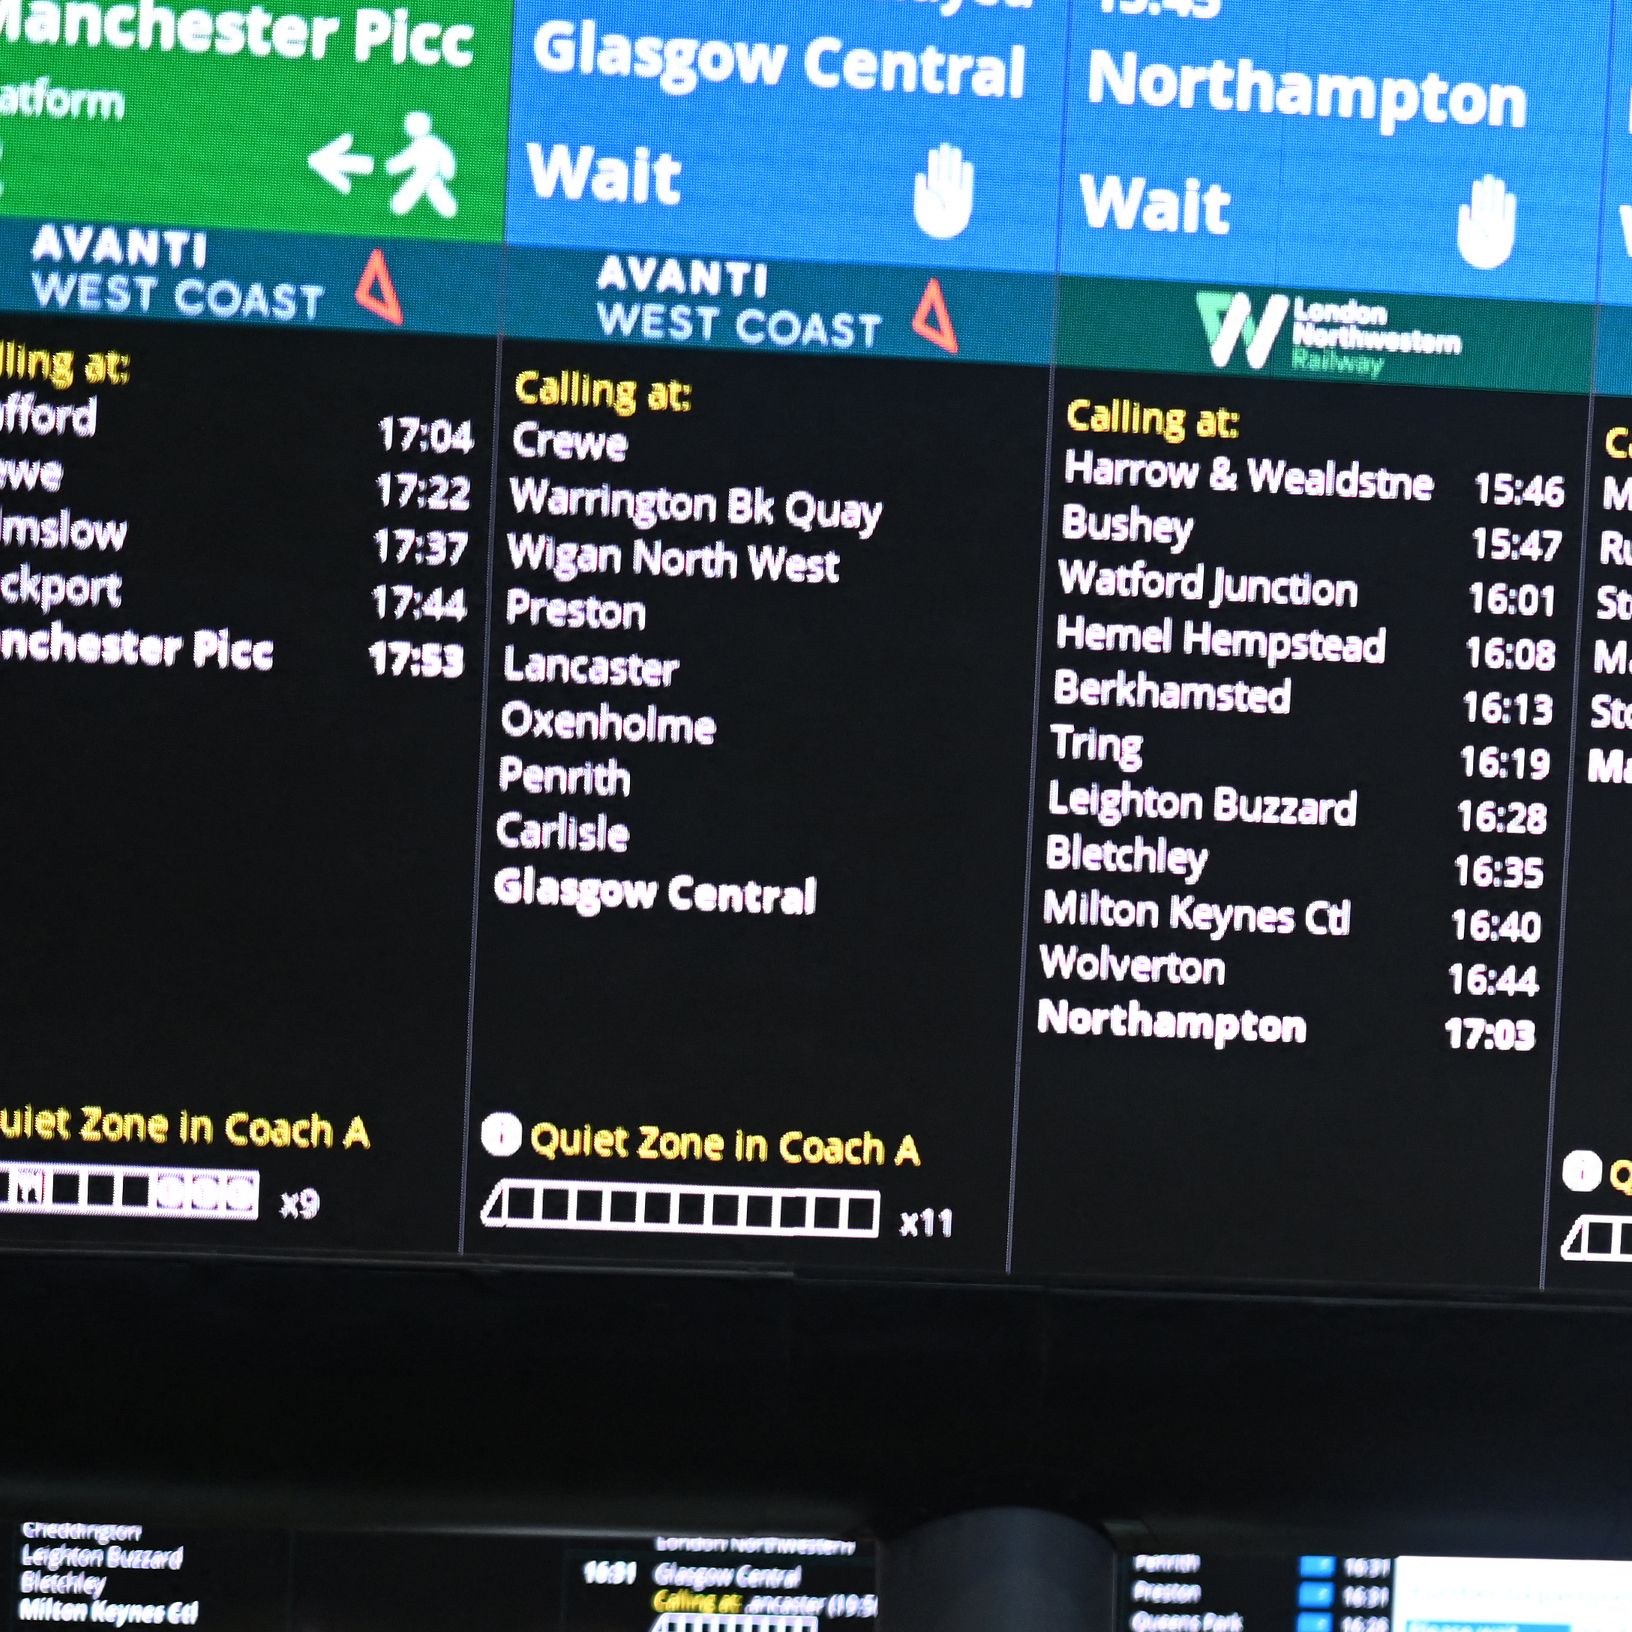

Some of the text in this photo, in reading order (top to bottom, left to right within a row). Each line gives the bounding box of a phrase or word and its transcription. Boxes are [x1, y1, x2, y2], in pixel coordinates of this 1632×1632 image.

[533, 18, 1027, 100] Glasgow Central
[1088, 48, 1528, 137] Northampton
[526, 142, 682, 206] Wait
[598, 256, 766, 297] AVANTI
[598, 303, 881, 347] WEST COAST
[515, 370, 691, 416] Calling at:
[1065, 449, 1565, 508] Harrow & Wealdstne 15:46
[510, 477, 883, 539] Warrington Bk Quay
[507, 533, 840, 583] Wigan North West
[494, 865, 817, 917] Glasgow Central
[1037, 998, 1536, 1051] Northampton 17:03
[531, 1122, 920, 1165] Quiet Zone in Coach A
[900, 1208, 952, 1236] x11
[653, 1562, 802, 1591] Glasgow Central
[19, 1597, 88, 1622] Milton
